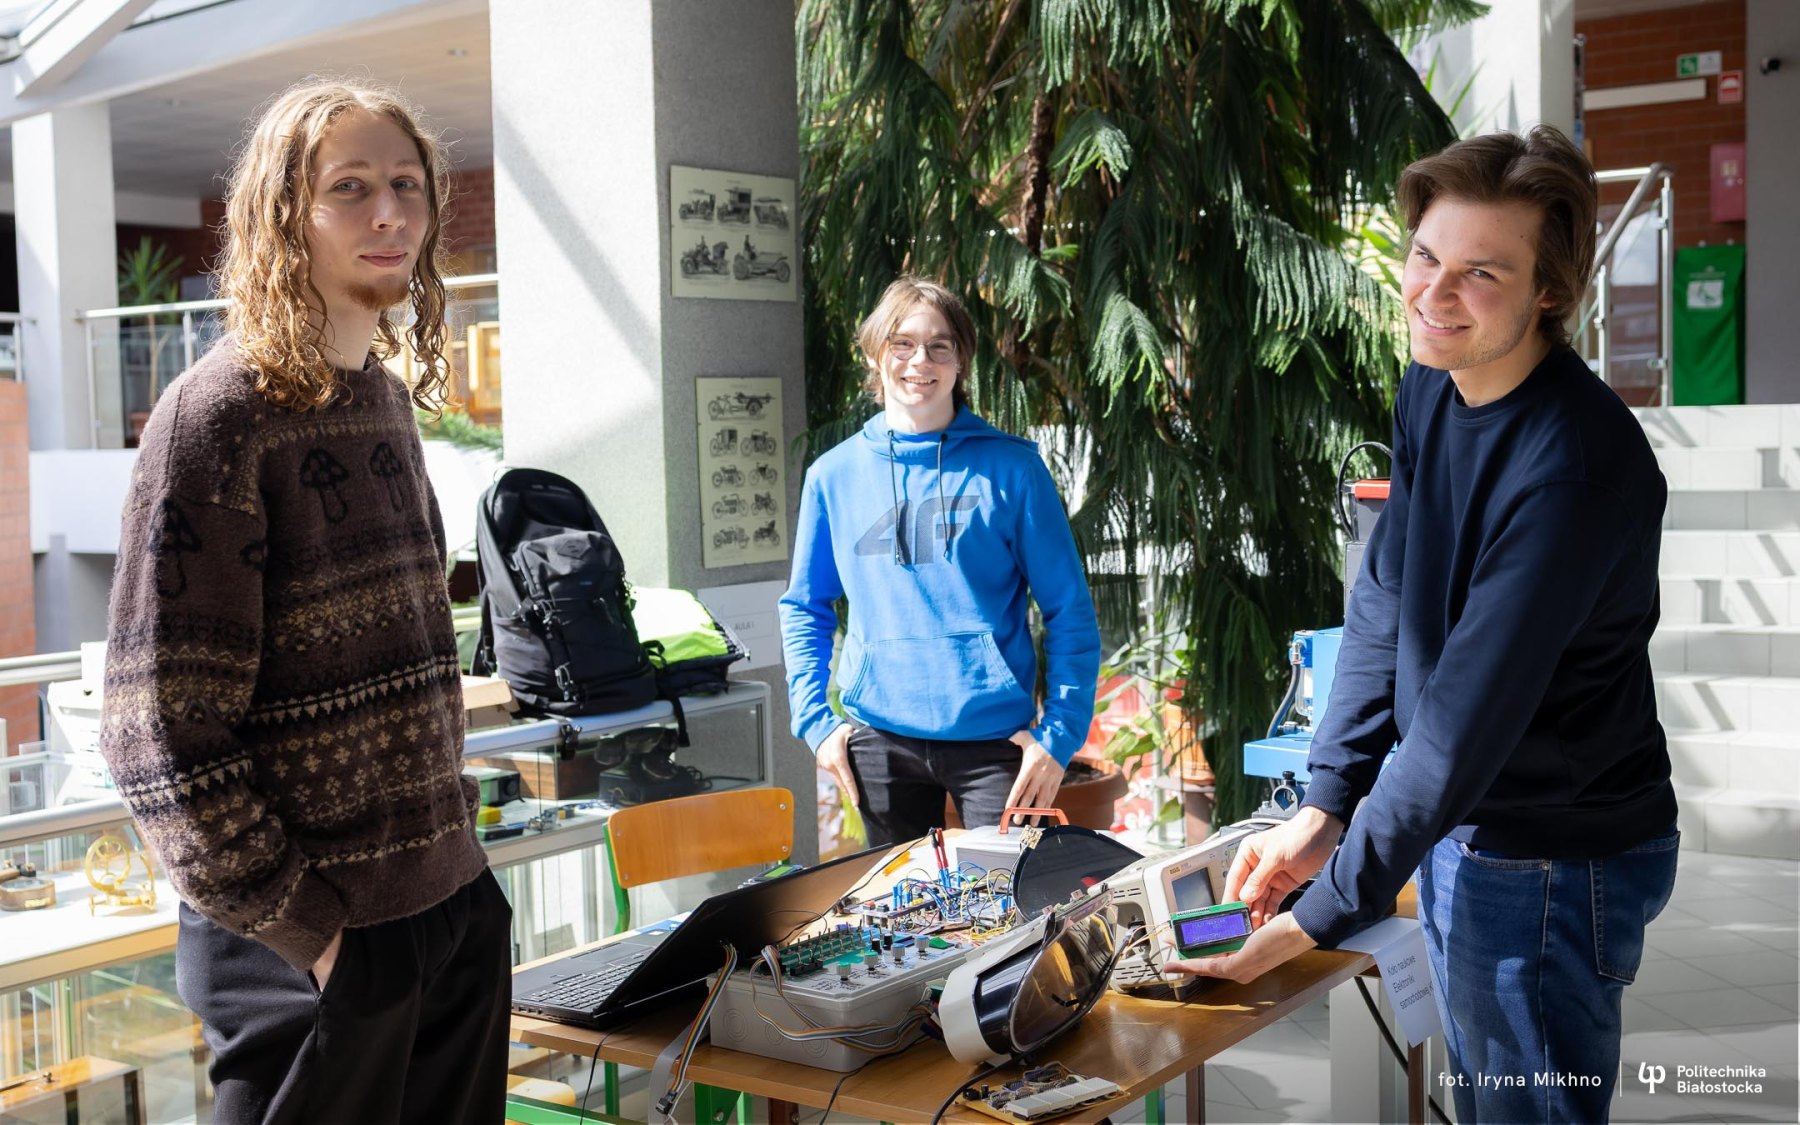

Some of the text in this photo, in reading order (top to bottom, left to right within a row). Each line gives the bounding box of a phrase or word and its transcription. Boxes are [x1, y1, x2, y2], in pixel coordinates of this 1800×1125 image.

[854, 495, 980, 565] 4F
[735, 621, 751, 631] AULA
[1397, 955, 1416, 972] naukowe
